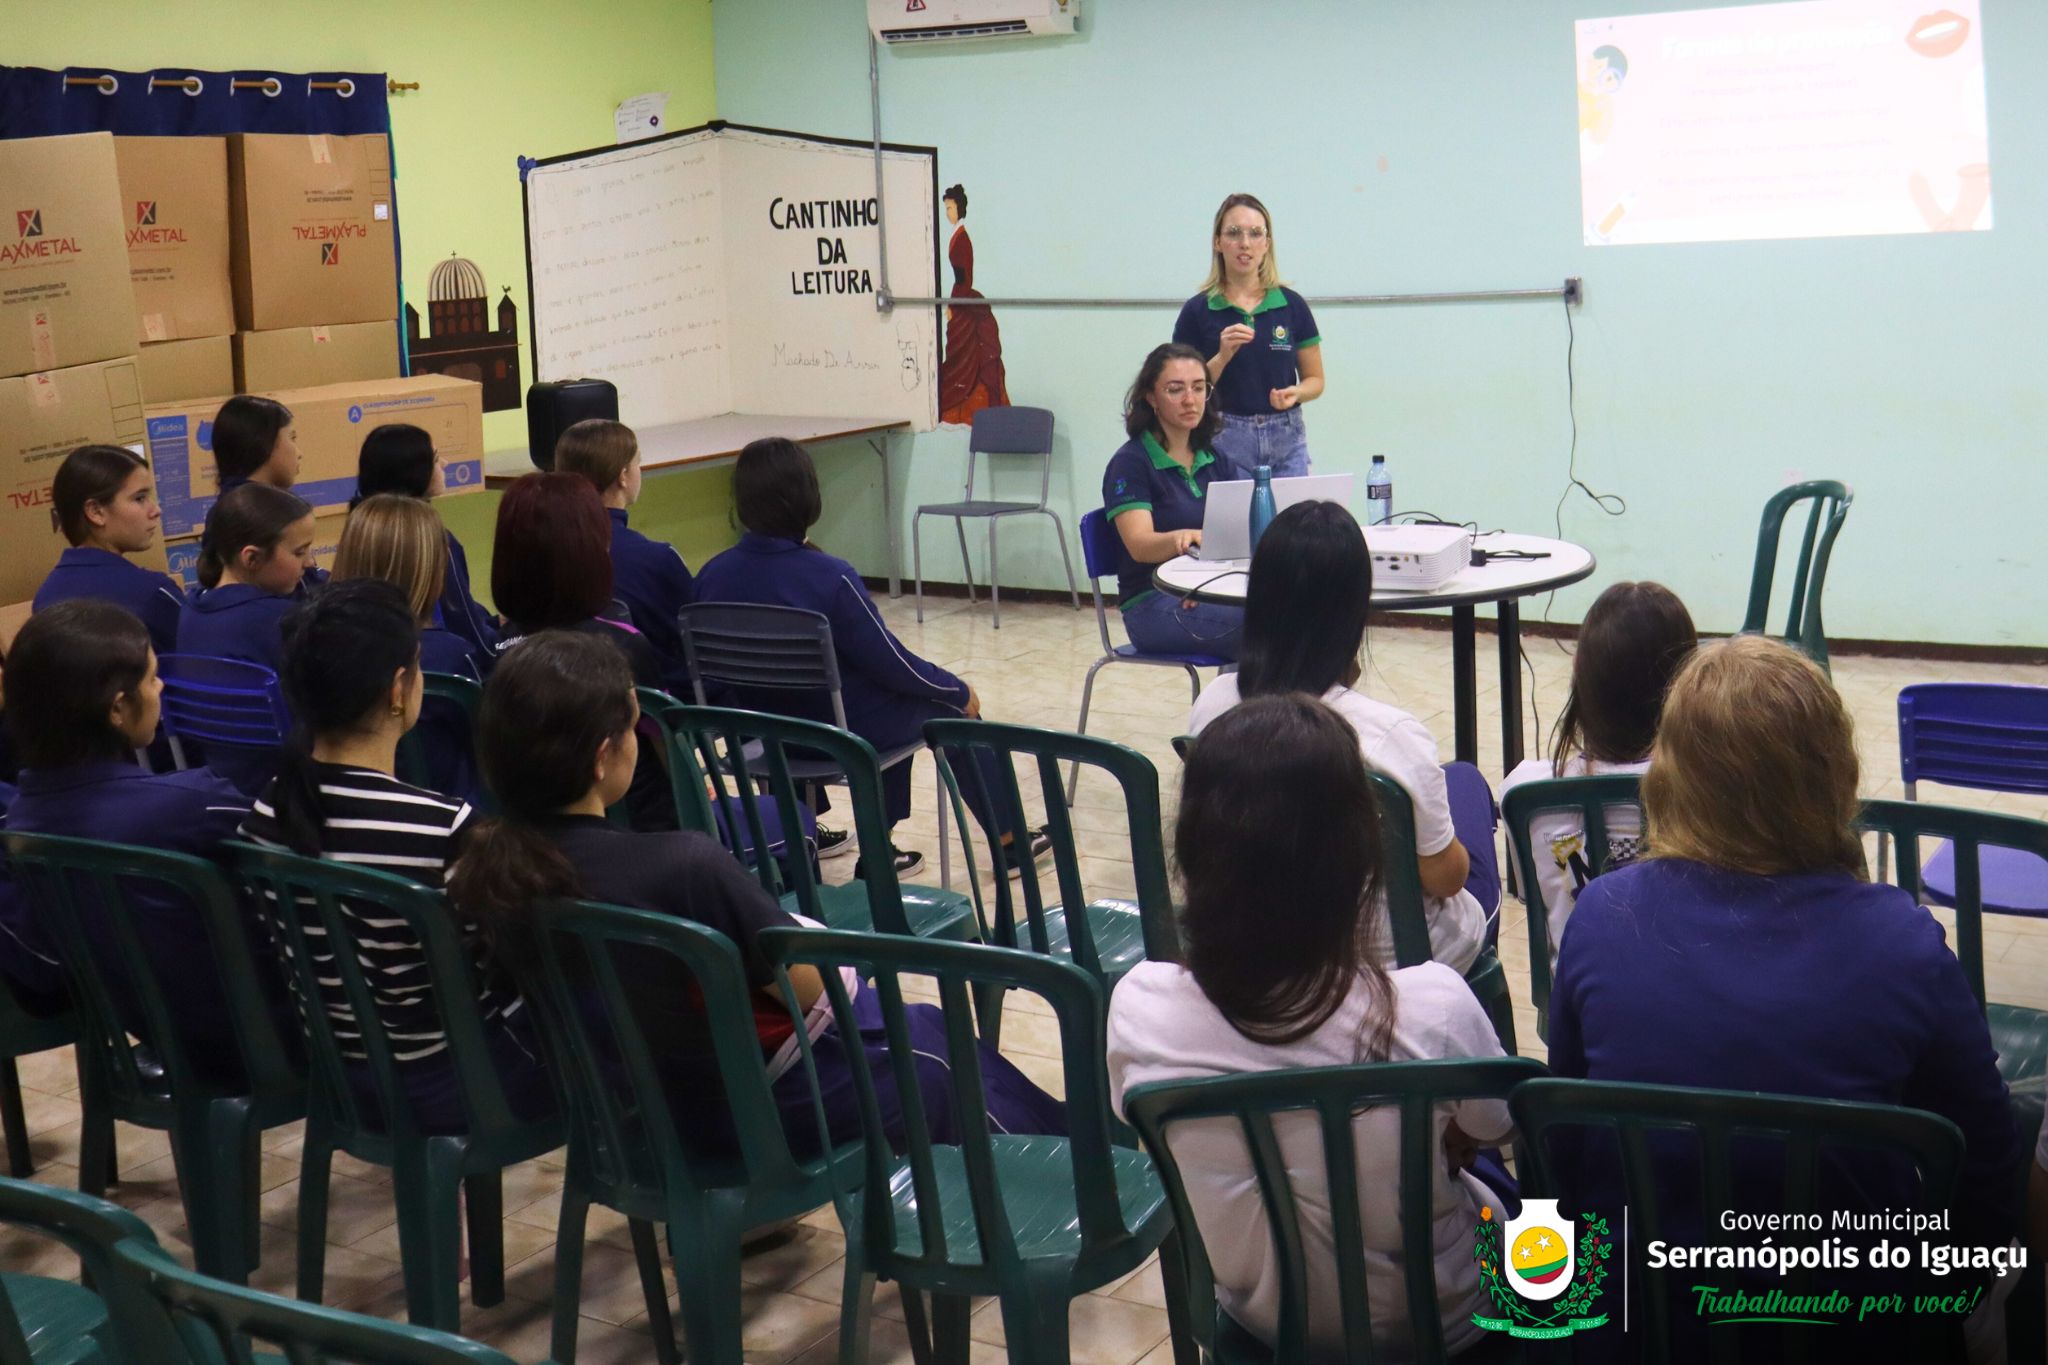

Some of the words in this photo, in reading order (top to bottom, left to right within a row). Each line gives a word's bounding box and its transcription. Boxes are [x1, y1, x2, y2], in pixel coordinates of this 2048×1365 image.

[770, 197, 879, 229] CANTINHO
[126, 227, 187, 248] XMETAL
[292, 222, 367, 241] PLAXMETAL
[0, 237, 82, 264] AXMETAL
[817, 237, 848, 265] DA
[792, 269, 873, 295] LEITURA
